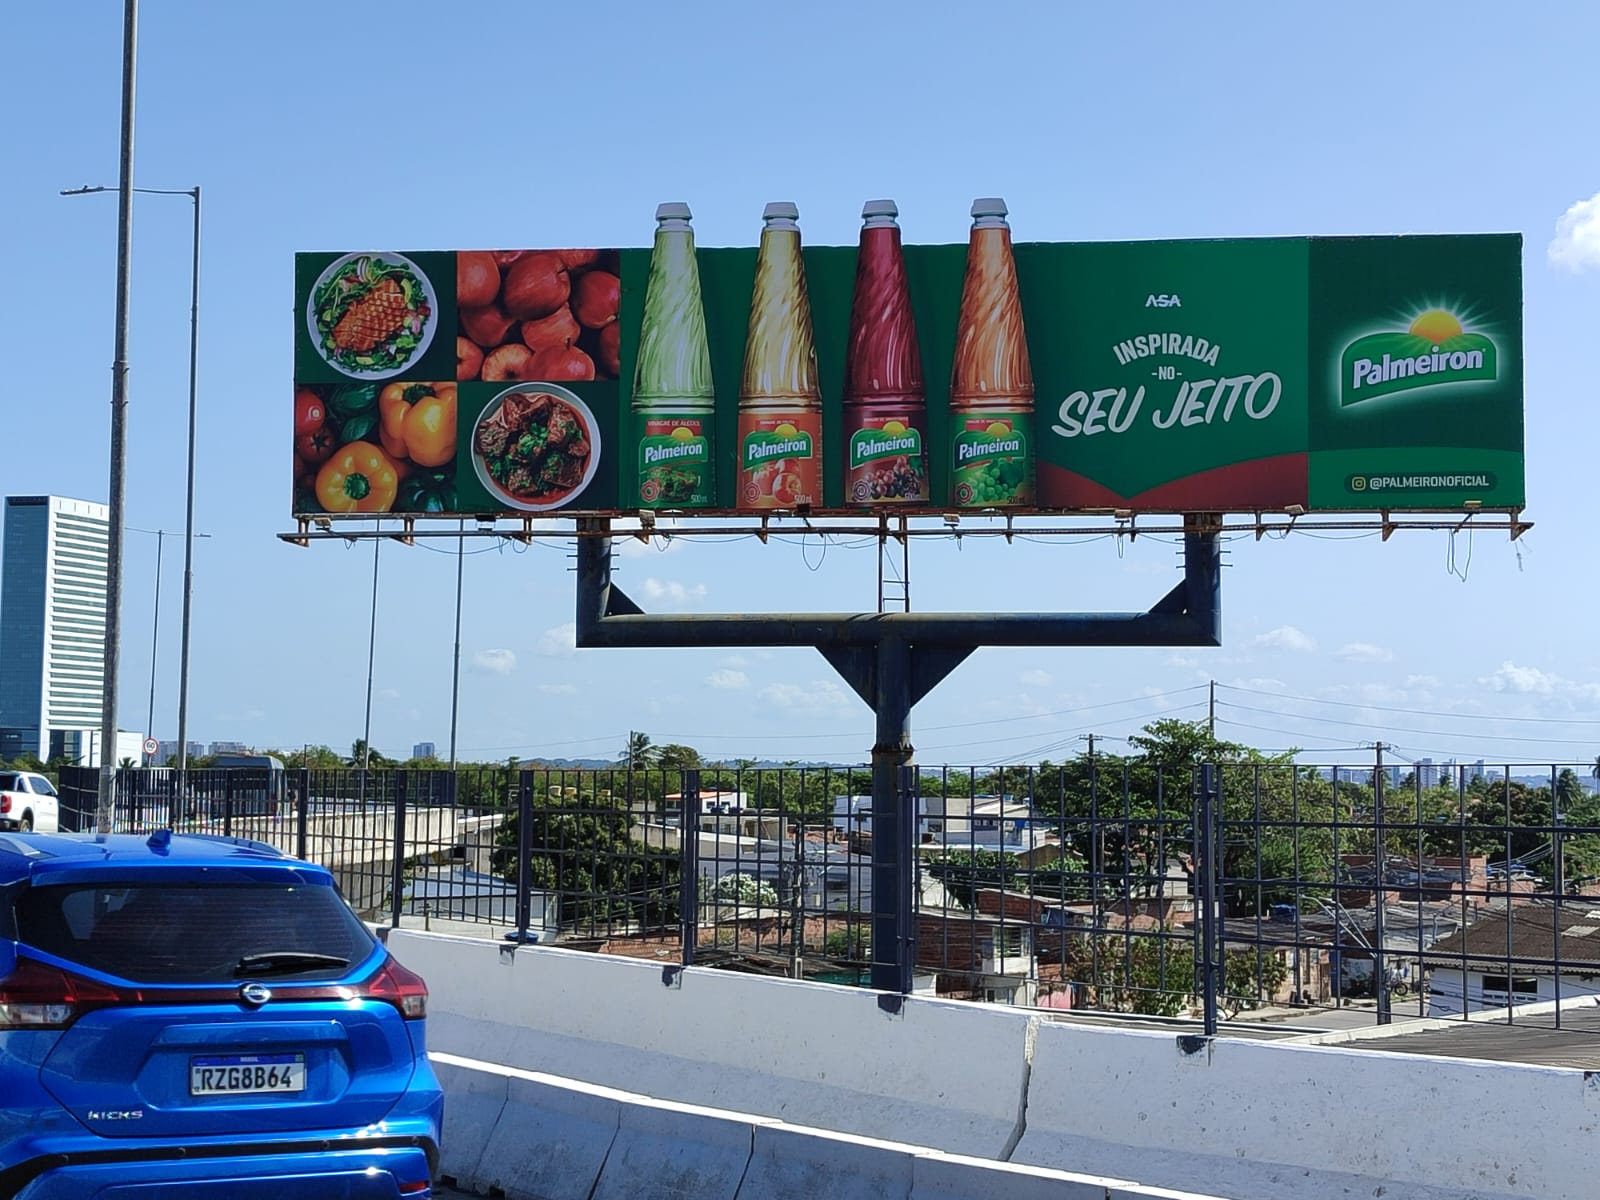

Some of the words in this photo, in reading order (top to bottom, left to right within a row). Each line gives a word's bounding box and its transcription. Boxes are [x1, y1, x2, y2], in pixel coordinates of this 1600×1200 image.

[1144, 294, 1181, 308] ASA
[1112, 333, 1221, 367] INSPIRADA
[1352, 345, 1484, 390] Palmeiron
[1051, 385, 1146, 438] SEU
[1152, 372, 1282, 430] JEITO
[644, 442, 703, 464] Palmeiron
[748, 438, 807, 460] Palmeiron
[856, 436, 915, 459] Palmeiron
[959, 437, 1019, 460] Palmeiron
[1369, 475, 1490, 490] @PALMEIRONOFICIAL
[201, 1066, 292, 1091] RZG8B64
[88, 1110, 143, 1121] KICKS
